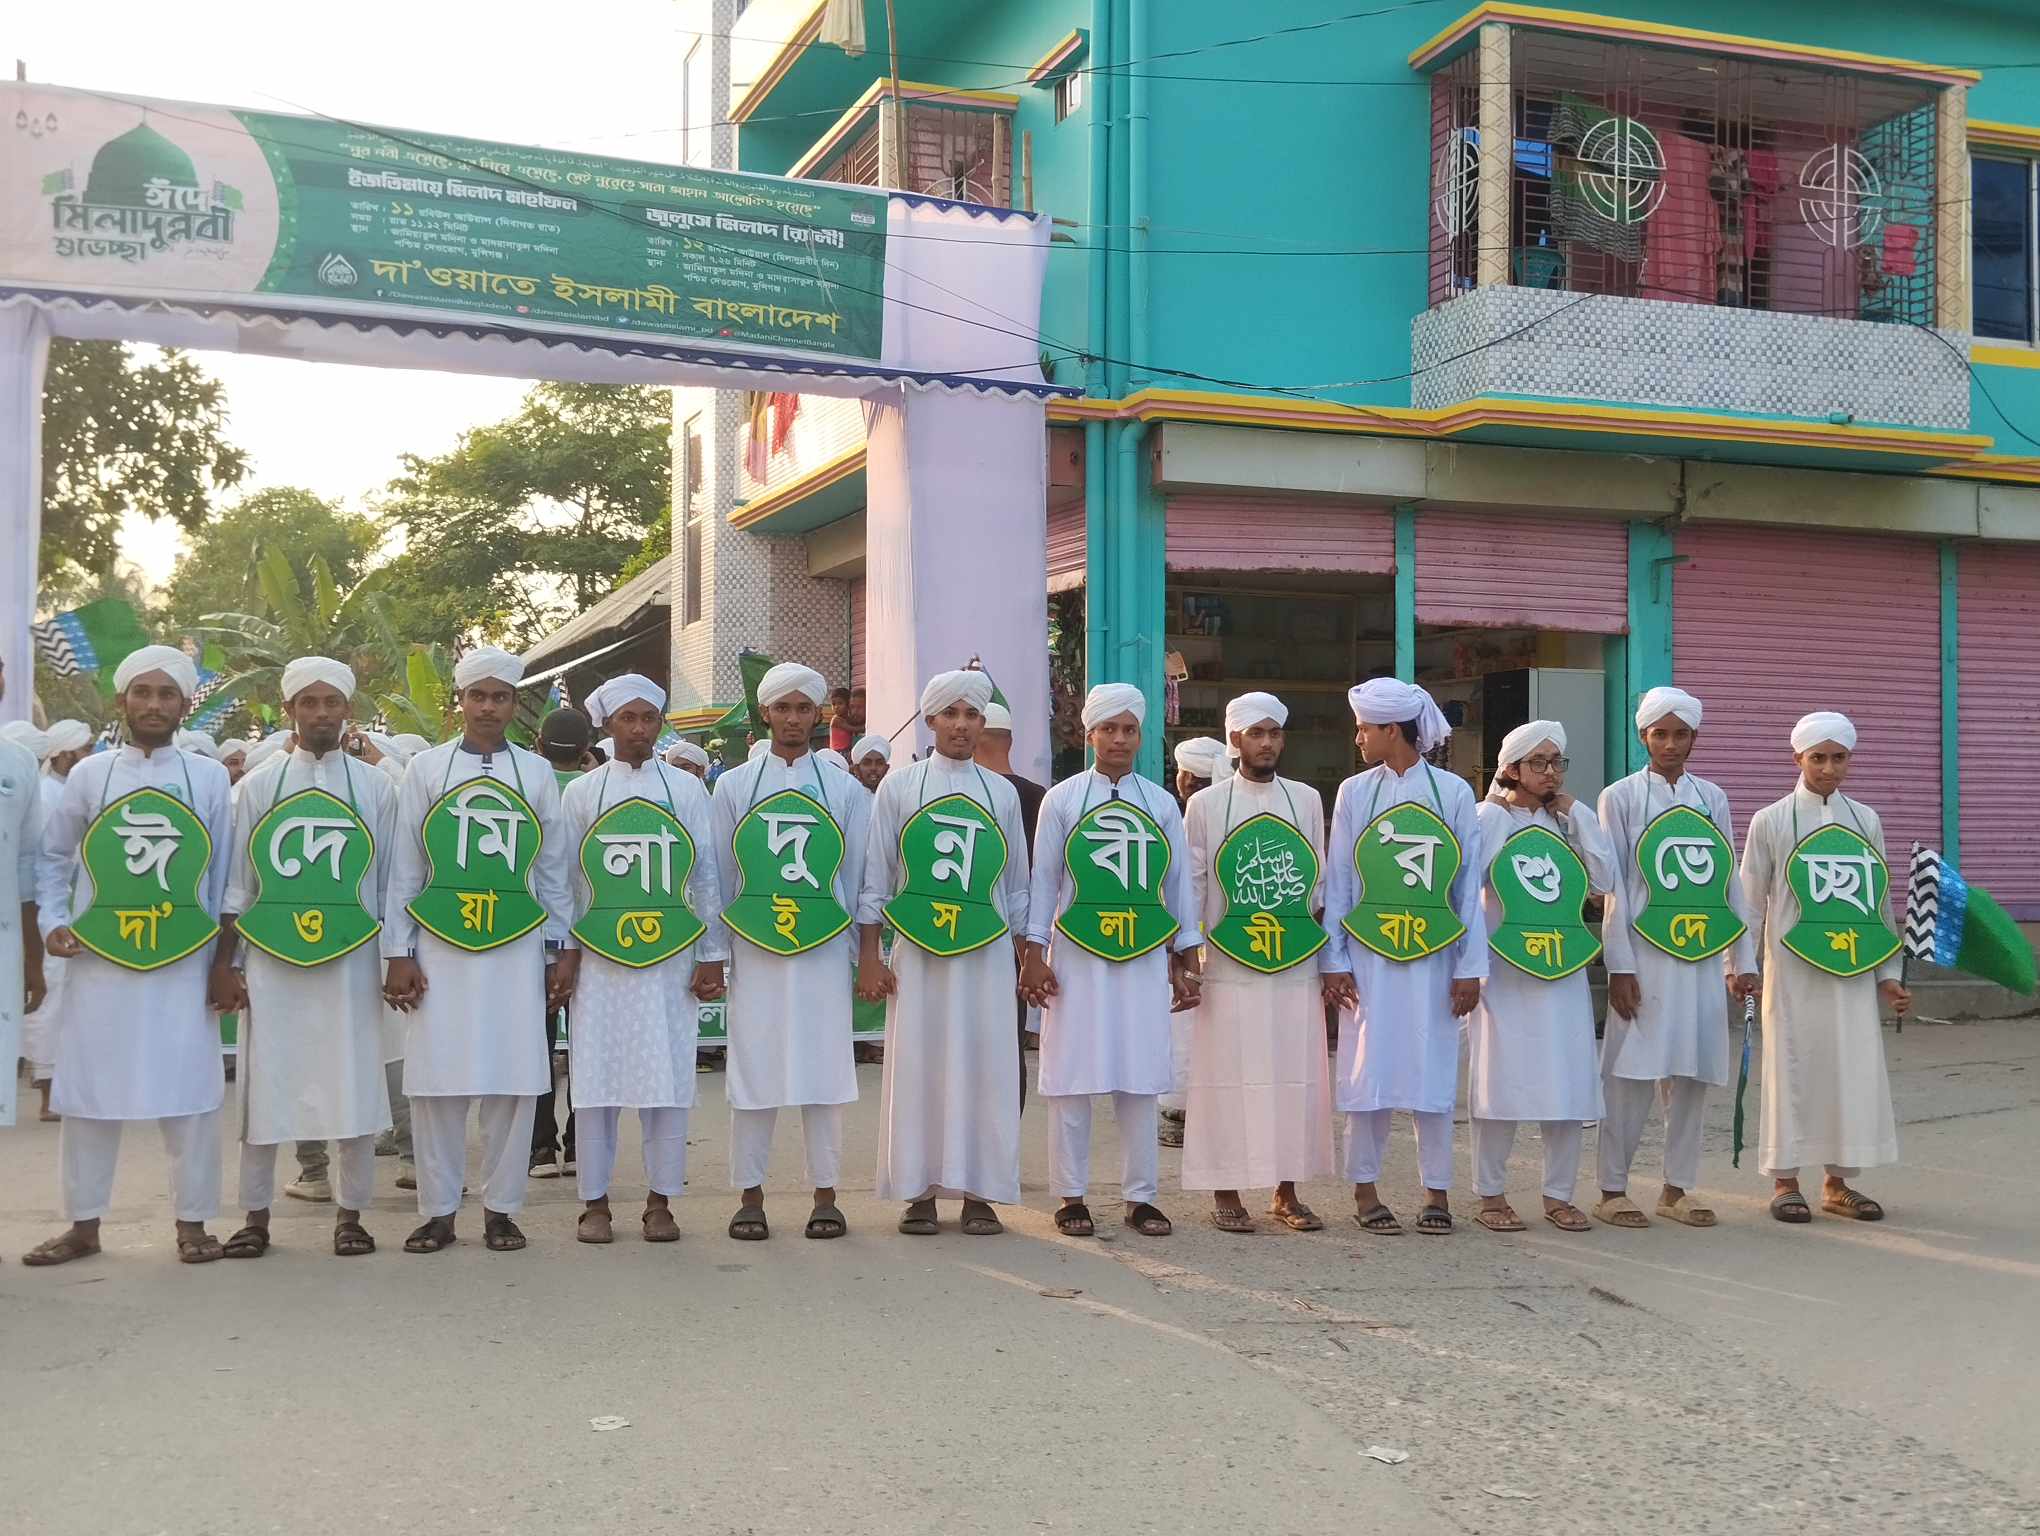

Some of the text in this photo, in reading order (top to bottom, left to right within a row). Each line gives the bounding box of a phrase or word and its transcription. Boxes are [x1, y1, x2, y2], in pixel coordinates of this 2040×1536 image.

[144, 177, 210, 212] ঈদে
[391, 201, 414, 216] ১১
[446, 178, 503, 203] মিলাদ
[51, 195, 236, 251] মিলাদুন্নবী
[646, 207, 712, 228] জুলুসে
[715, 213, 779, 238] মিলাদ
[683, 236, 705, 252] ১২
[55, 236, 147, 264] শুভেচ্ছা
[549, 273, 681, 317] ইসলামী
[690, 294, 843, 335] বাংলাদেশ
[112, 804, 183, 892] ঈ
[270, 817, 357, 881] দে
[447, 785, 527, 873] মি
[1081, 810, 1159, 891] বী
[595, 824, 682, 895] লা
[757, 812, 822, 891] দু
[928, 812, 998, 894] ন্ন
[1655, 836, 1717, 892] ভে
[1511, 851, 1561, 904] শু
[1797, 846, 1881, 917] চ্ছা
[294, 909, 325, 942] ও
[455, 889, 498, 933] য়া
[616, 910, 664, 948] তে
[771, 893, 801, 948] ই
[930, 901, 961, 941] স
[1097, 907, 1138, 948] লা
[1376, 910, 1430, 954] বাং
[1668, 913, 1709, 948] দে
[1243, 911, 1288, 961] মী
[1520, 928, 1566, 968] লা
[1825, 927, 1858, 966] শ
